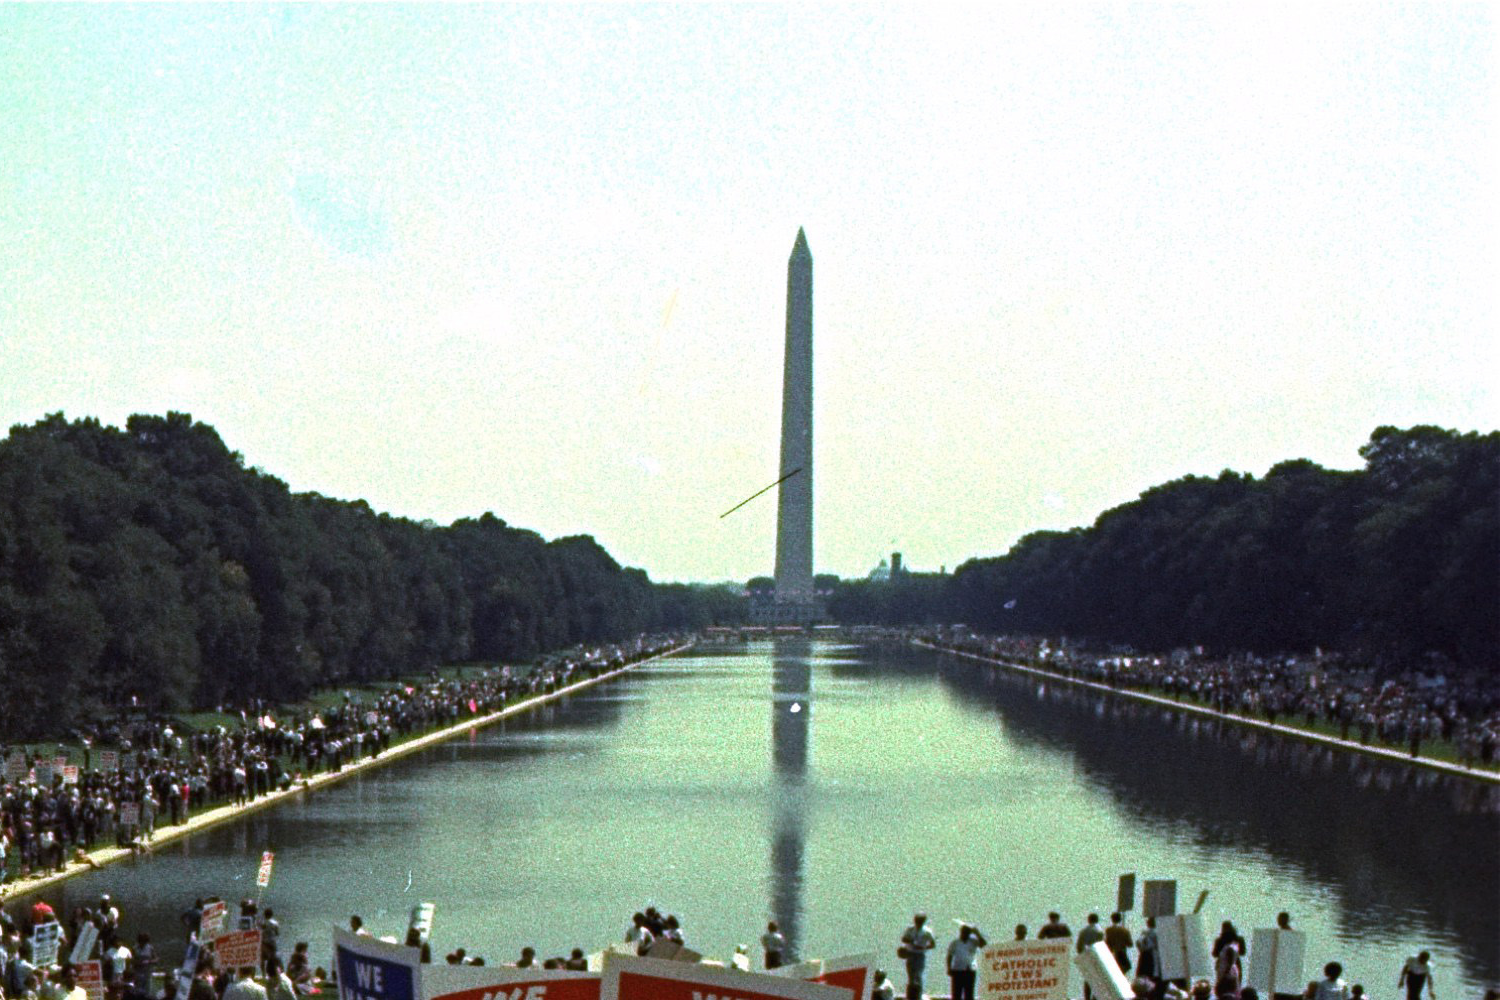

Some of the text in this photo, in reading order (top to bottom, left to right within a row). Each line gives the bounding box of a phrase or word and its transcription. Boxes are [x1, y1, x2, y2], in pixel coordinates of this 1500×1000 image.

[993, 957, 1057, 972] CATHOLIC
[355, 961, 383, 993] WE
[988, 977, 1058, 992] PROTESTANT
